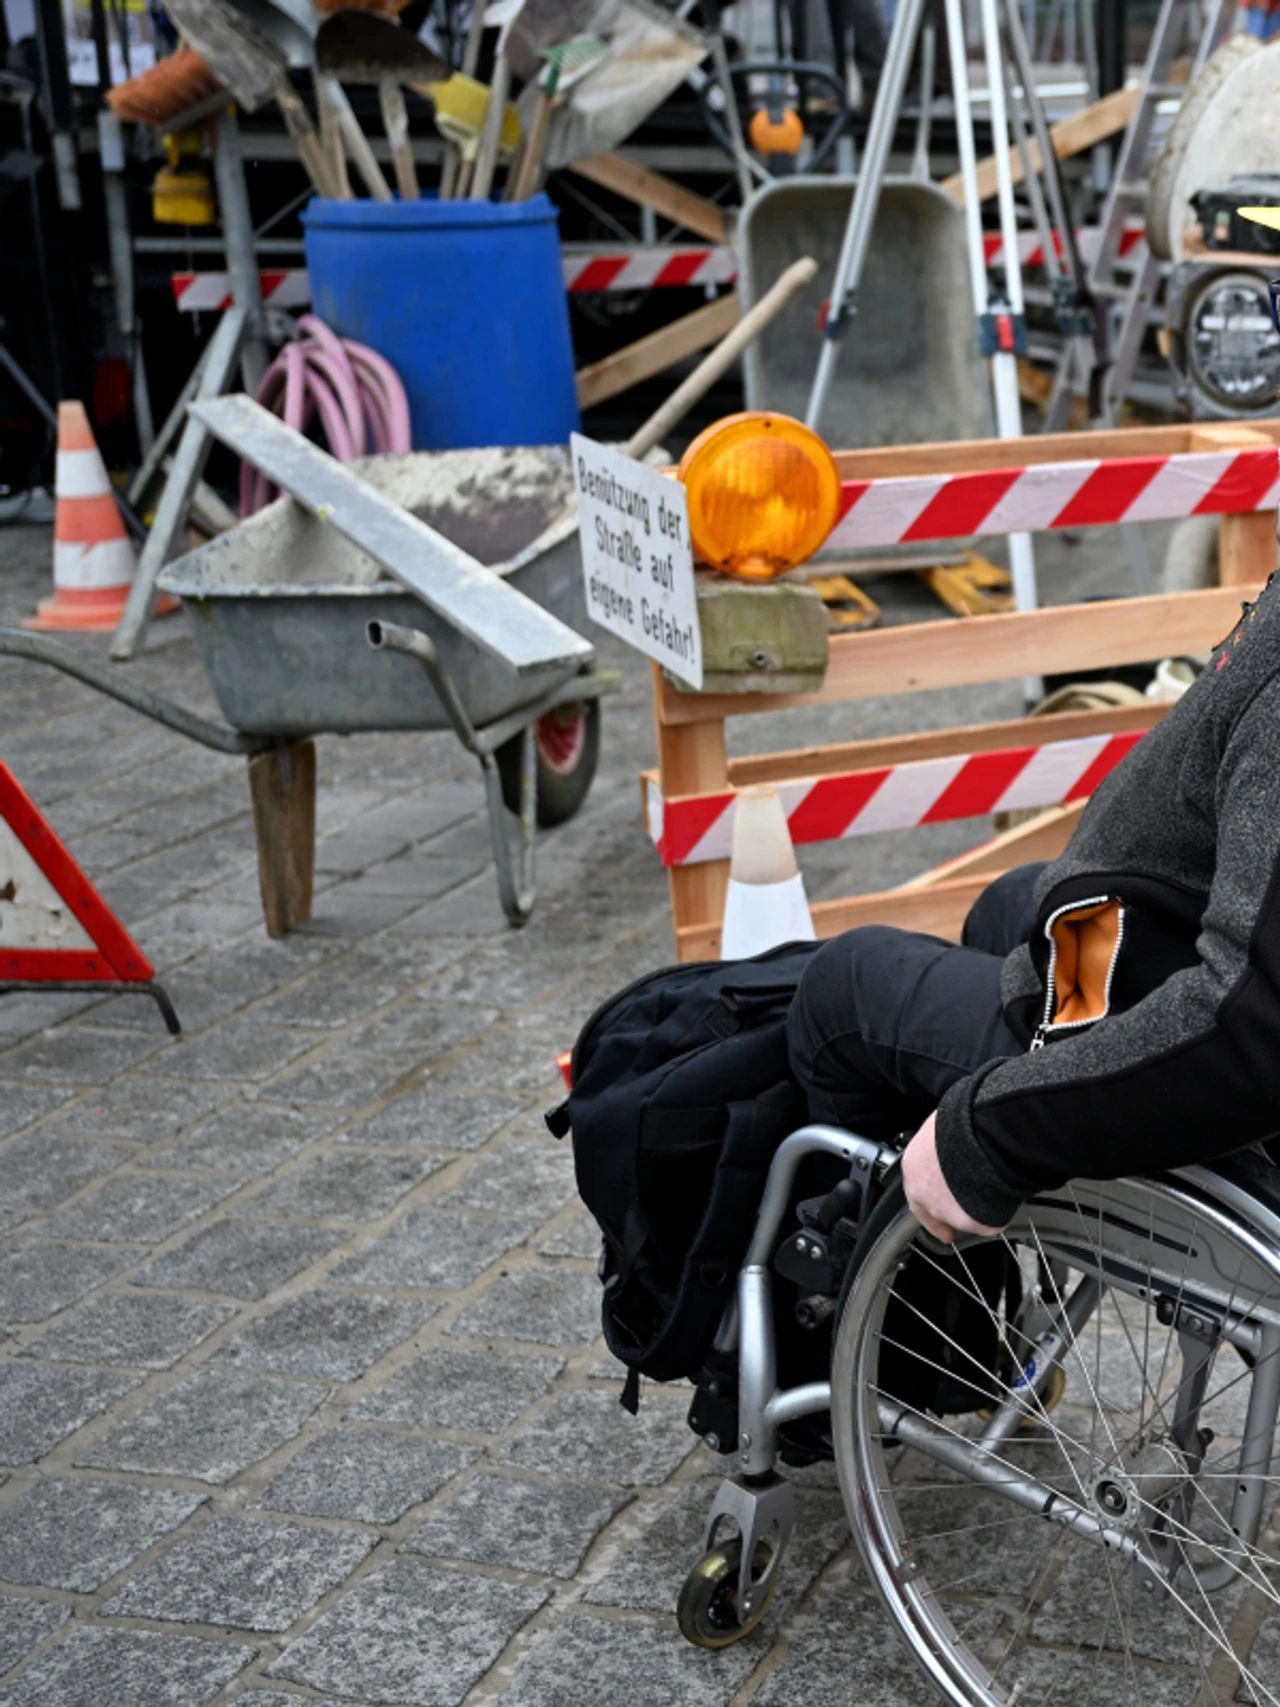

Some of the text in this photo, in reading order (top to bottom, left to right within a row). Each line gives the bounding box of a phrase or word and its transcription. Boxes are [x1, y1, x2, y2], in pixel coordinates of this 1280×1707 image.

[578, 457, 682, 542] Benützung der
[595, 514, 675, 592] Straße auf
[590, 569, 695, 664] eigene Gefahr!
